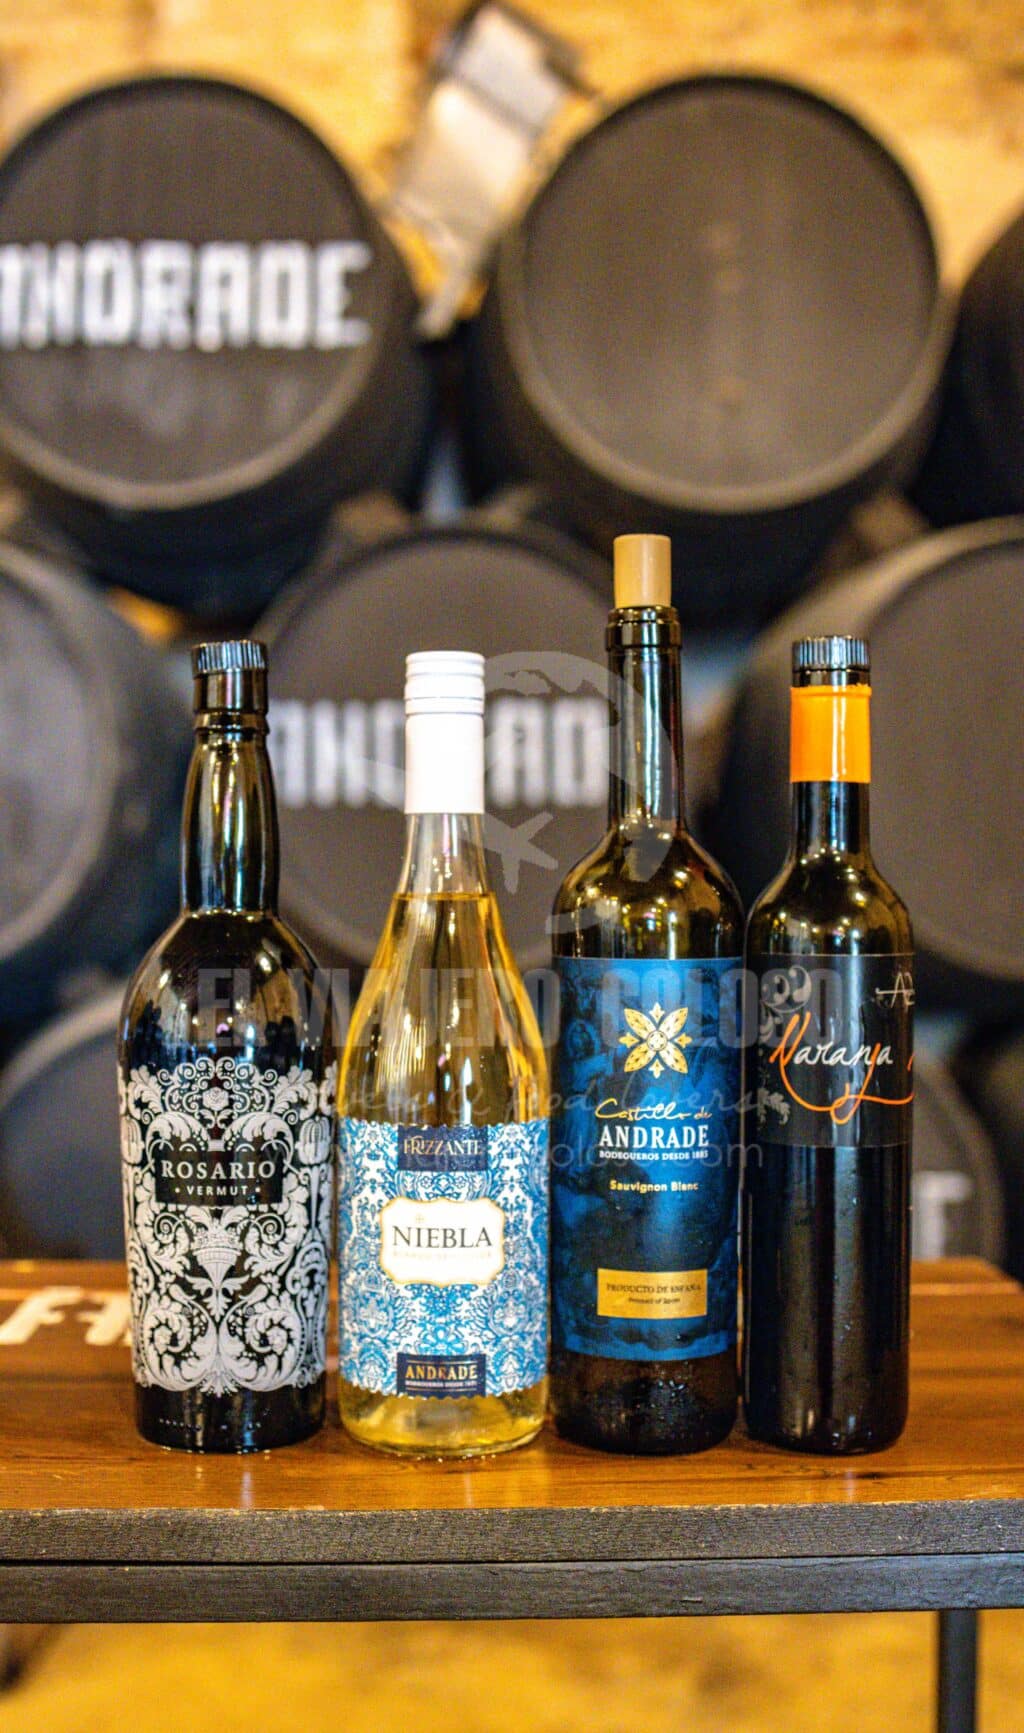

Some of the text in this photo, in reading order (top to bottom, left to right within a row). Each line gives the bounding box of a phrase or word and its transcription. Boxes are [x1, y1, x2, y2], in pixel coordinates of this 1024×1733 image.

[595, 1098, 691, 1121] Castillo
[403, 1135, 484, 1156] FRIZZANTE
[600, 1125, 709, 1149] ANDRADE
[600, 1150, 660, 1161] BODEGUEROS
[662, 1151, 690, 1161] DESDE
[161, 1159, 276, 1180] ROSARIO
[187, 1185, 249, 1197] VERMUT
[609, 1179, 699, 1194] Sauvignon Blanc
[393, 1225, 493, 1249] NIEBLA
[405, 1364, 478, 1380] ANDRADE
